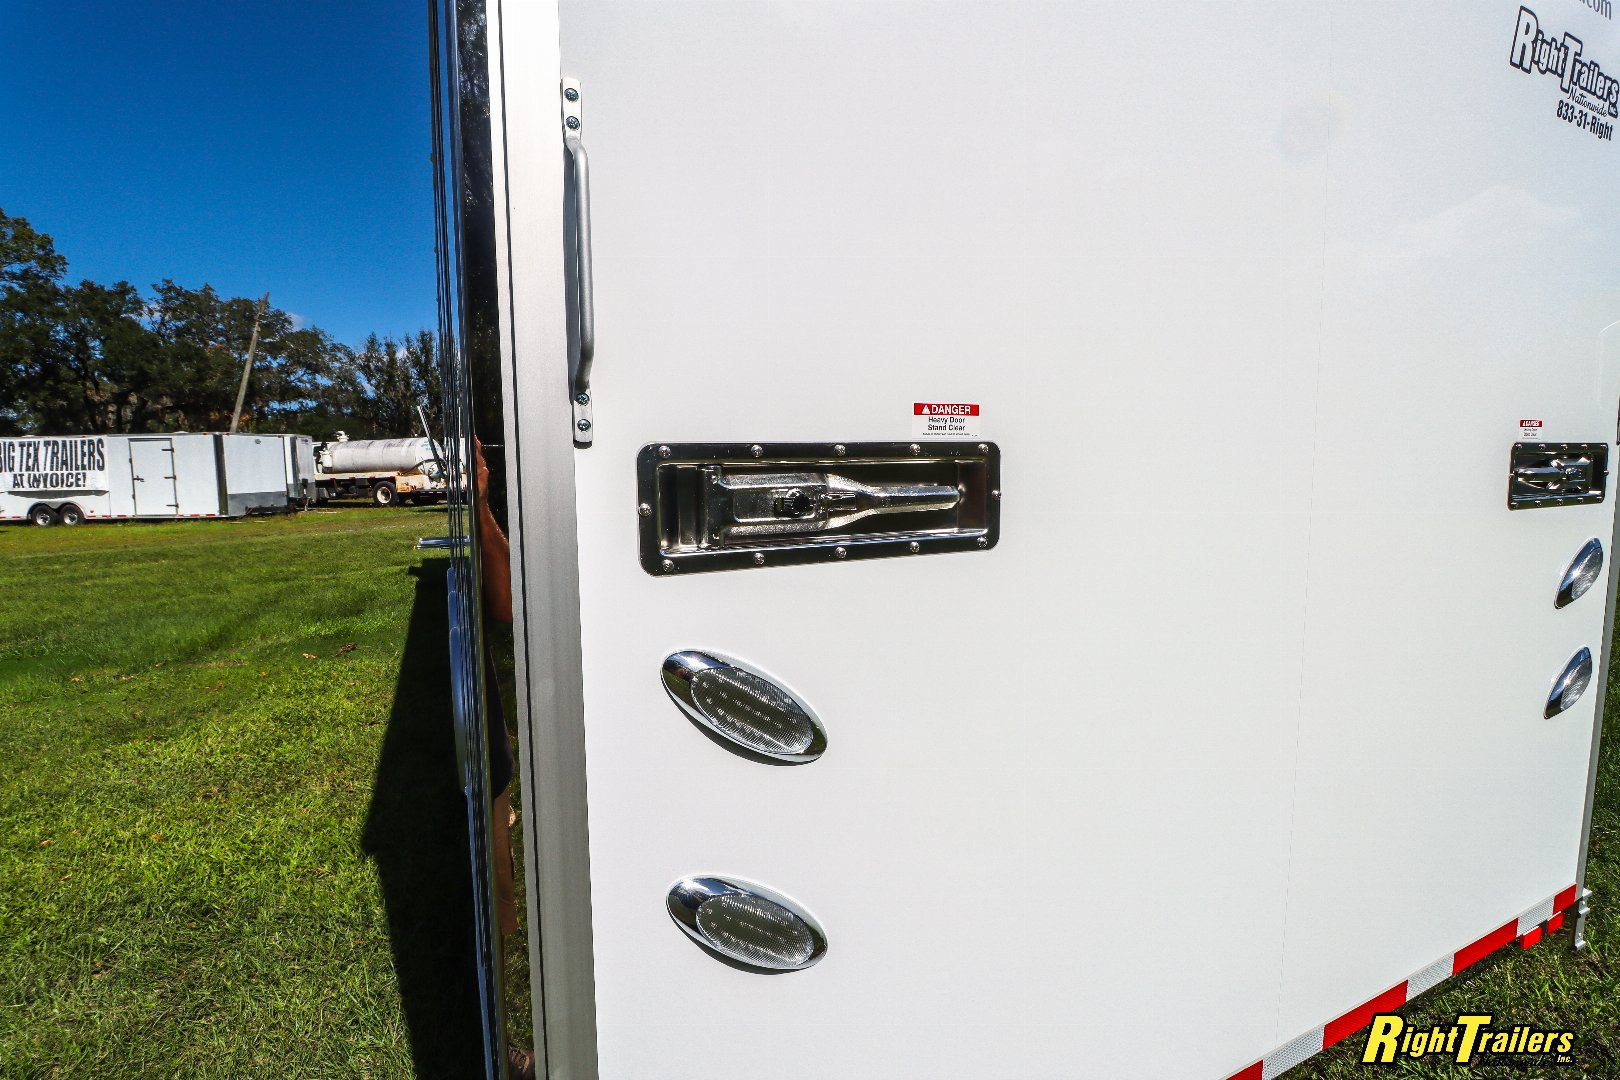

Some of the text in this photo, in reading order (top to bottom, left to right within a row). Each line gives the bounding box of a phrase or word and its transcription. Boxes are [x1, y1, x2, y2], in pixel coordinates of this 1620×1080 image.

[1557, 99, 1613, 141] 833-31-Right
[931, 405, 971, 415] DANGER
[928, 416, 966, 424] Heavy Door
[18, 440, 40, 473] TEX
[43, 438, 105, 472] TRAILERS
[12, 473, 25, 489] AT
